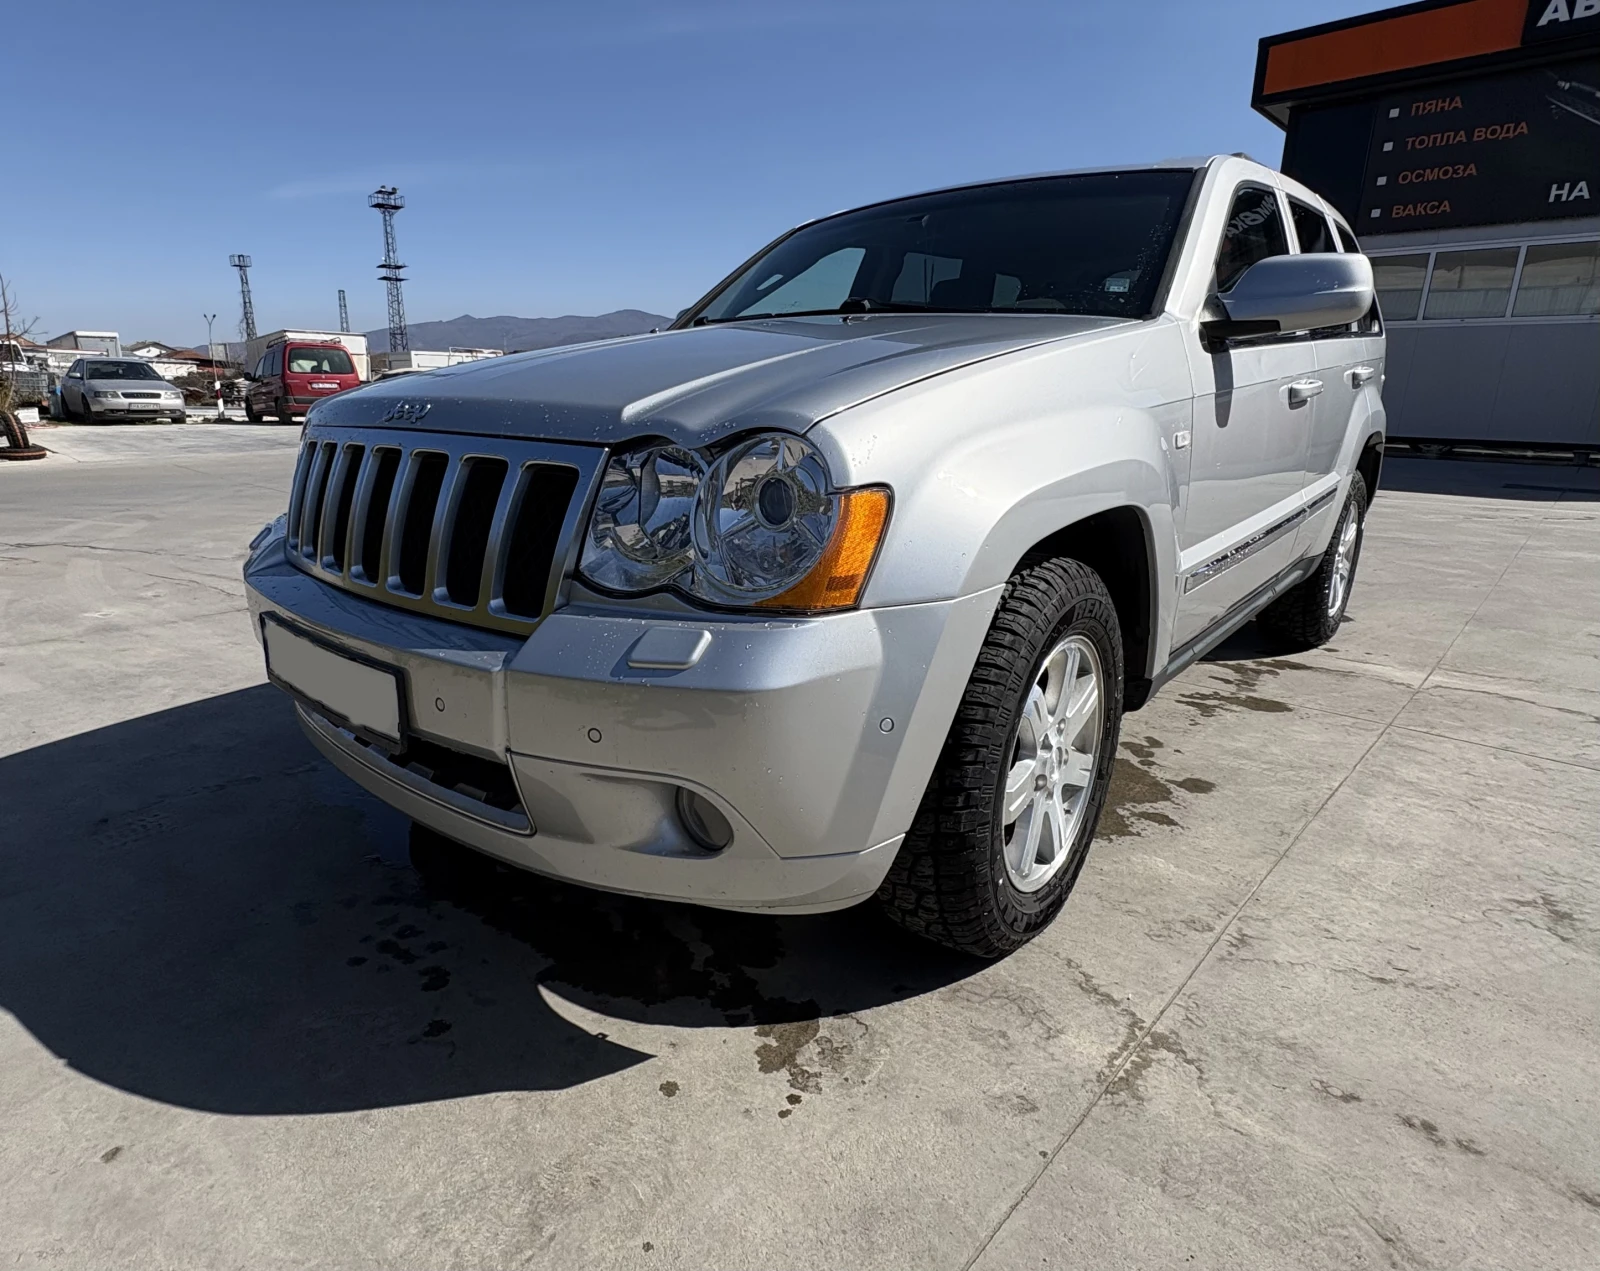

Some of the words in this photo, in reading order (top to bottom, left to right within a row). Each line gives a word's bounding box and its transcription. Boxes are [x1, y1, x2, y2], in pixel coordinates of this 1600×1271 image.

[1410, 96, 1463, 117] ПЯНА
[1405, 130, 1467, 151] ТОПЛА
[1472, 121, 1529, 142] ВОДА
[1398, 163, 1478, 185] ОСМОЗА
[1548, 181, 1591, 203] НА
[1391, 200, 1451, 218] ВАКСА
[382, 400, 431, 424] Jeep
